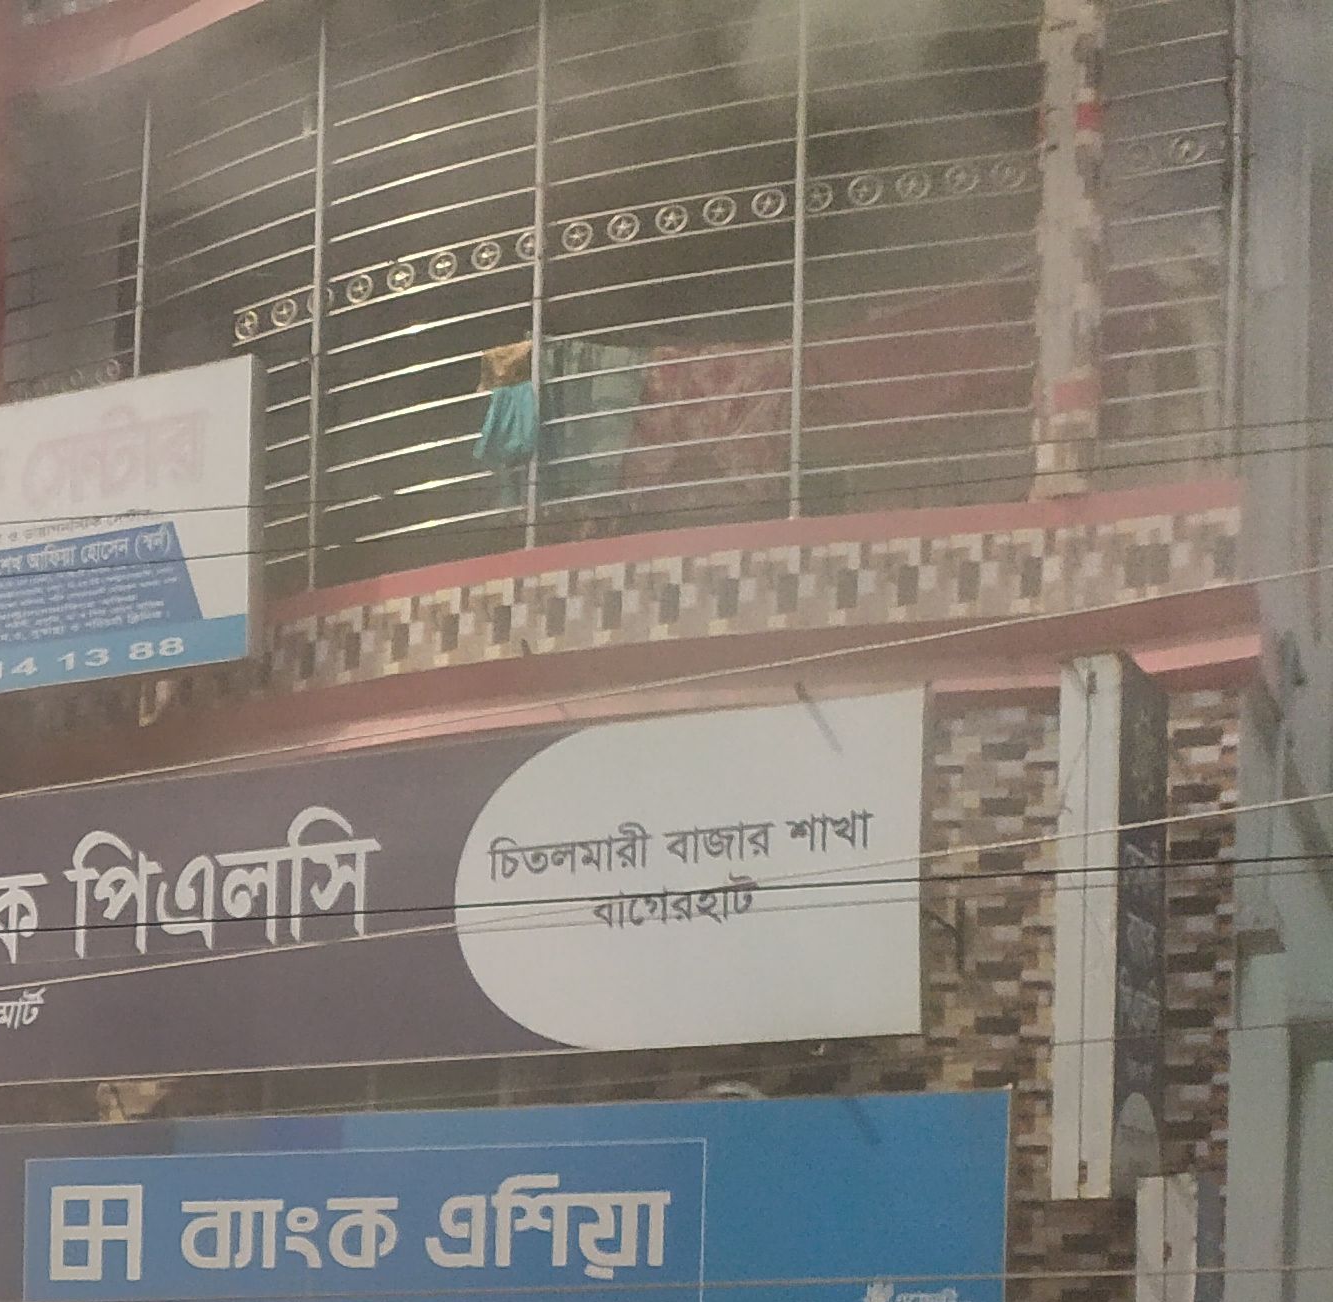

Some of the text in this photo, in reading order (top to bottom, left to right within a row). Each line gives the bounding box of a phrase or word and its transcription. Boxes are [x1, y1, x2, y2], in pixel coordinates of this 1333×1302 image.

[64, 805, 382, 958] পিএলসি
[487, 809, 873, 881] চিতলমারী বাজার শাখা
[593, 872, 759, 929] বাগেরহাট
[180, 1173, 672, 1280] ব্যাংক এশিয়া
